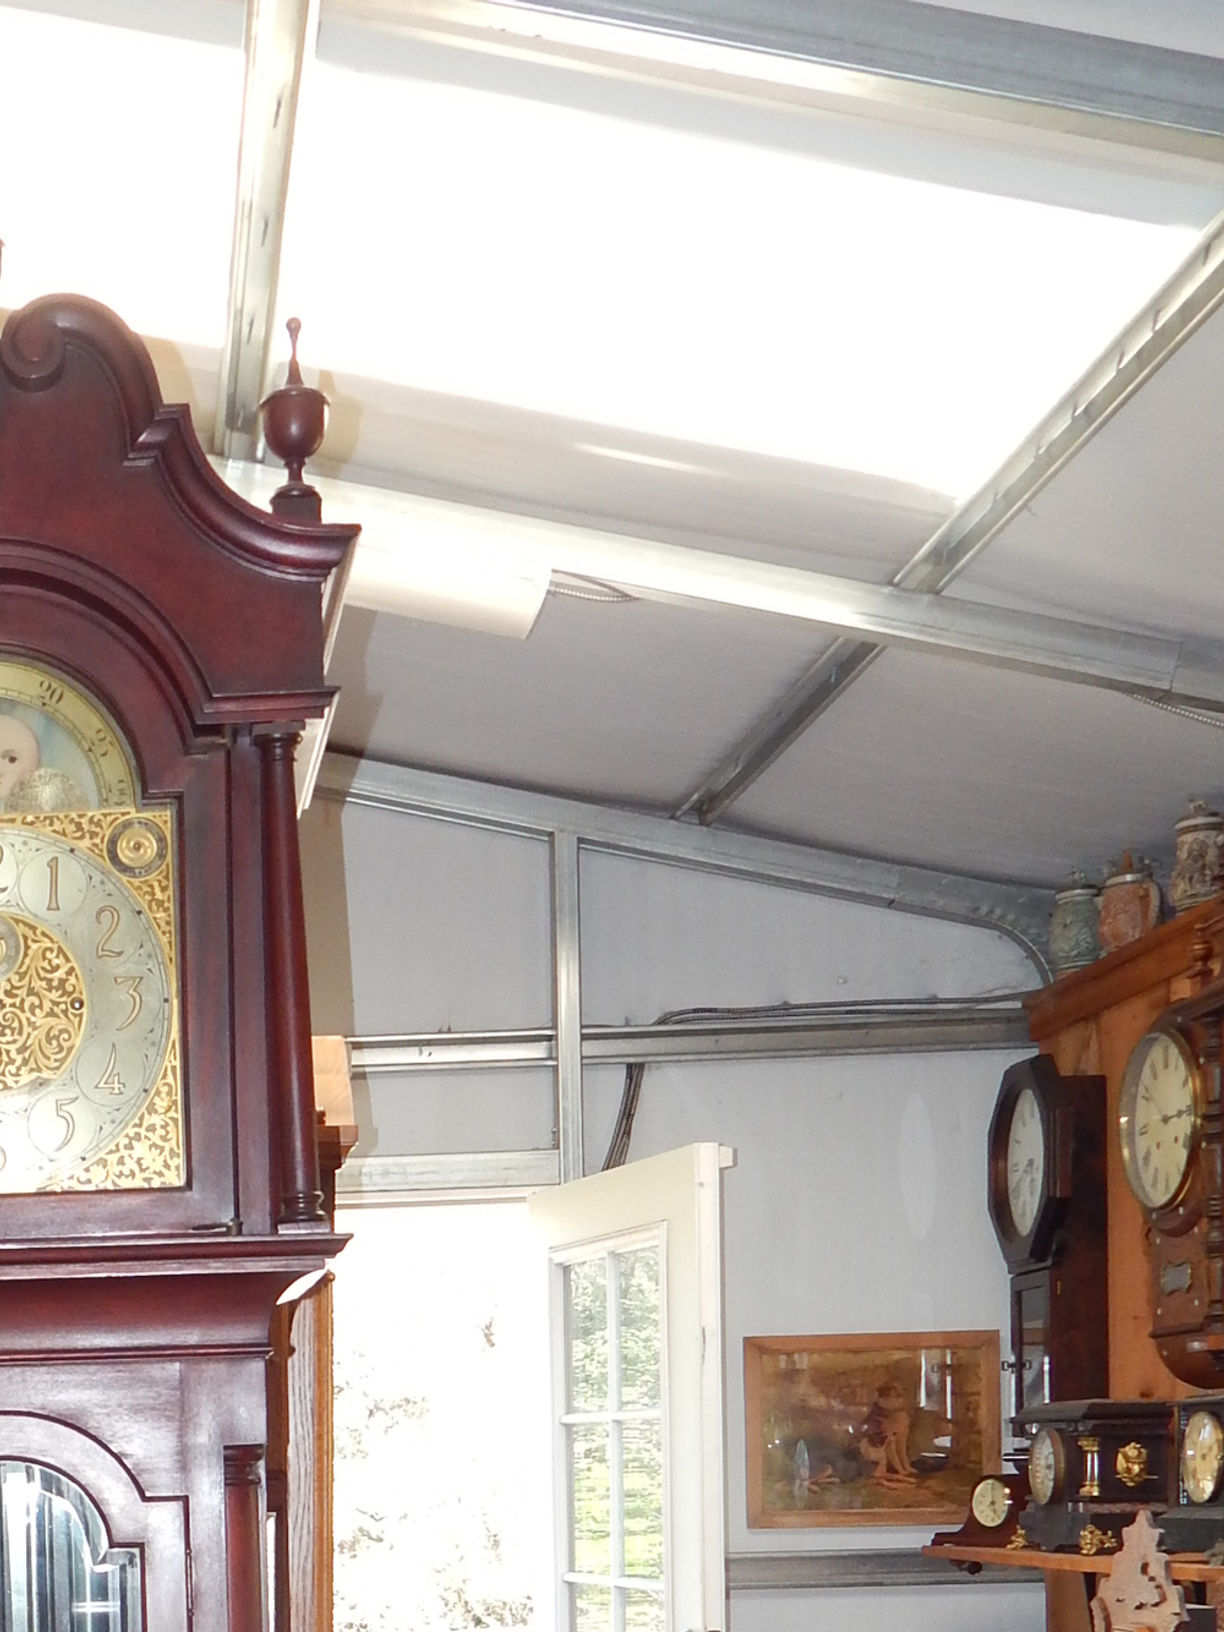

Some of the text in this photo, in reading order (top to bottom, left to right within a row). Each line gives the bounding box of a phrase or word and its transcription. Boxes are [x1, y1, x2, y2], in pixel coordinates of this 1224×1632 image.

[38, 679, 64, 705] 20
[46, 857, 60, 911] 1
[96, 905, 124, 960] 2
[114, 976, 143, 1032] 3
[95, 1043, 126, 1095] 4
[54, 1096, 79, 1152] 5
